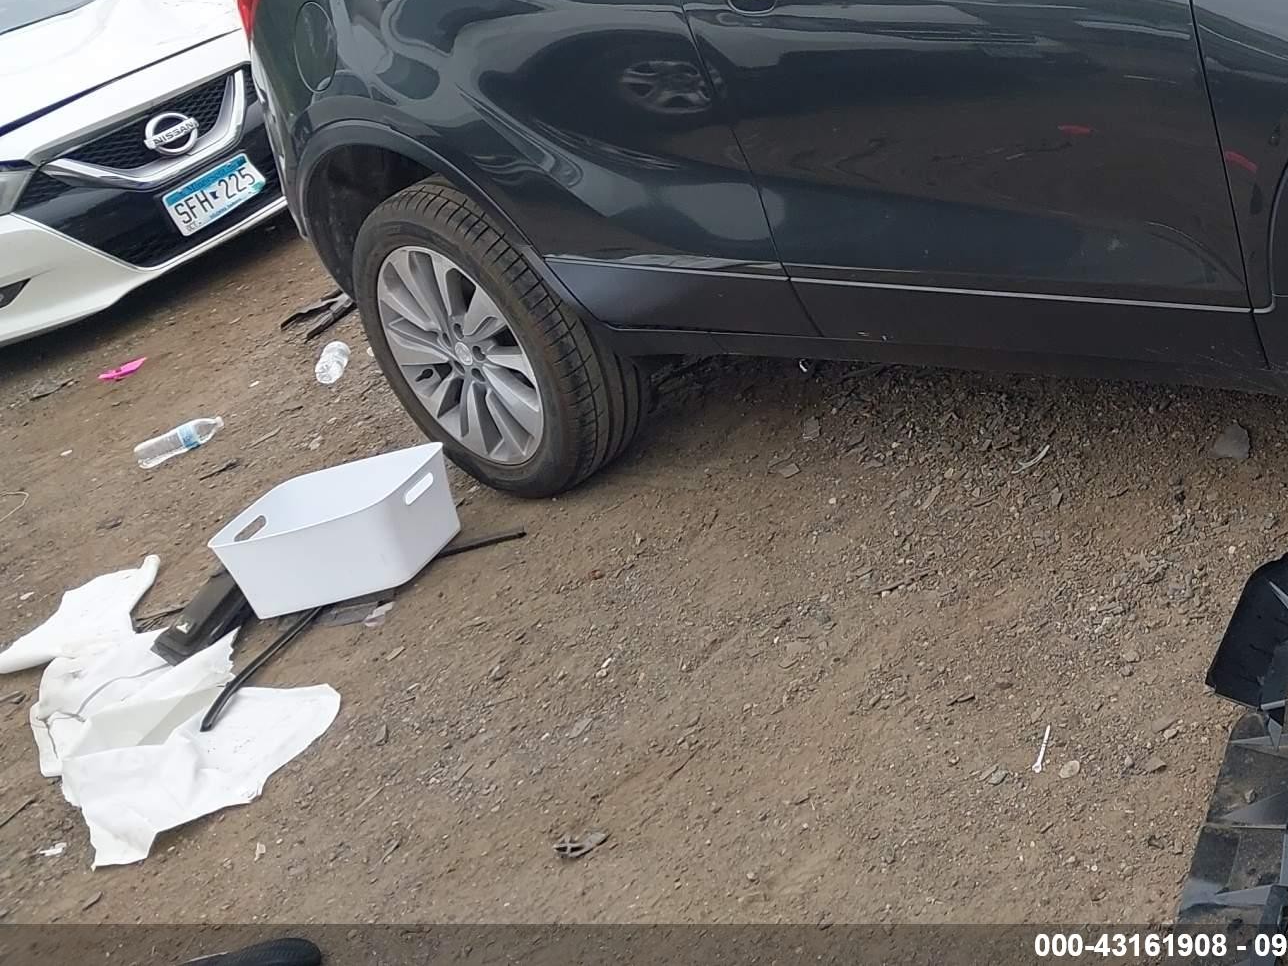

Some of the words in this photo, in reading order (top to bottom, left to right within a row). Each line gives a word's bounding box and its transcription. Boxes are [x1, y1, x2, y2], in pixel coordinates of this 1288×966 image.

[153, 122, 195, 145] NISSAN
[174, 189, 214, 224] SFH
[218, 166, 255, 199] 225
